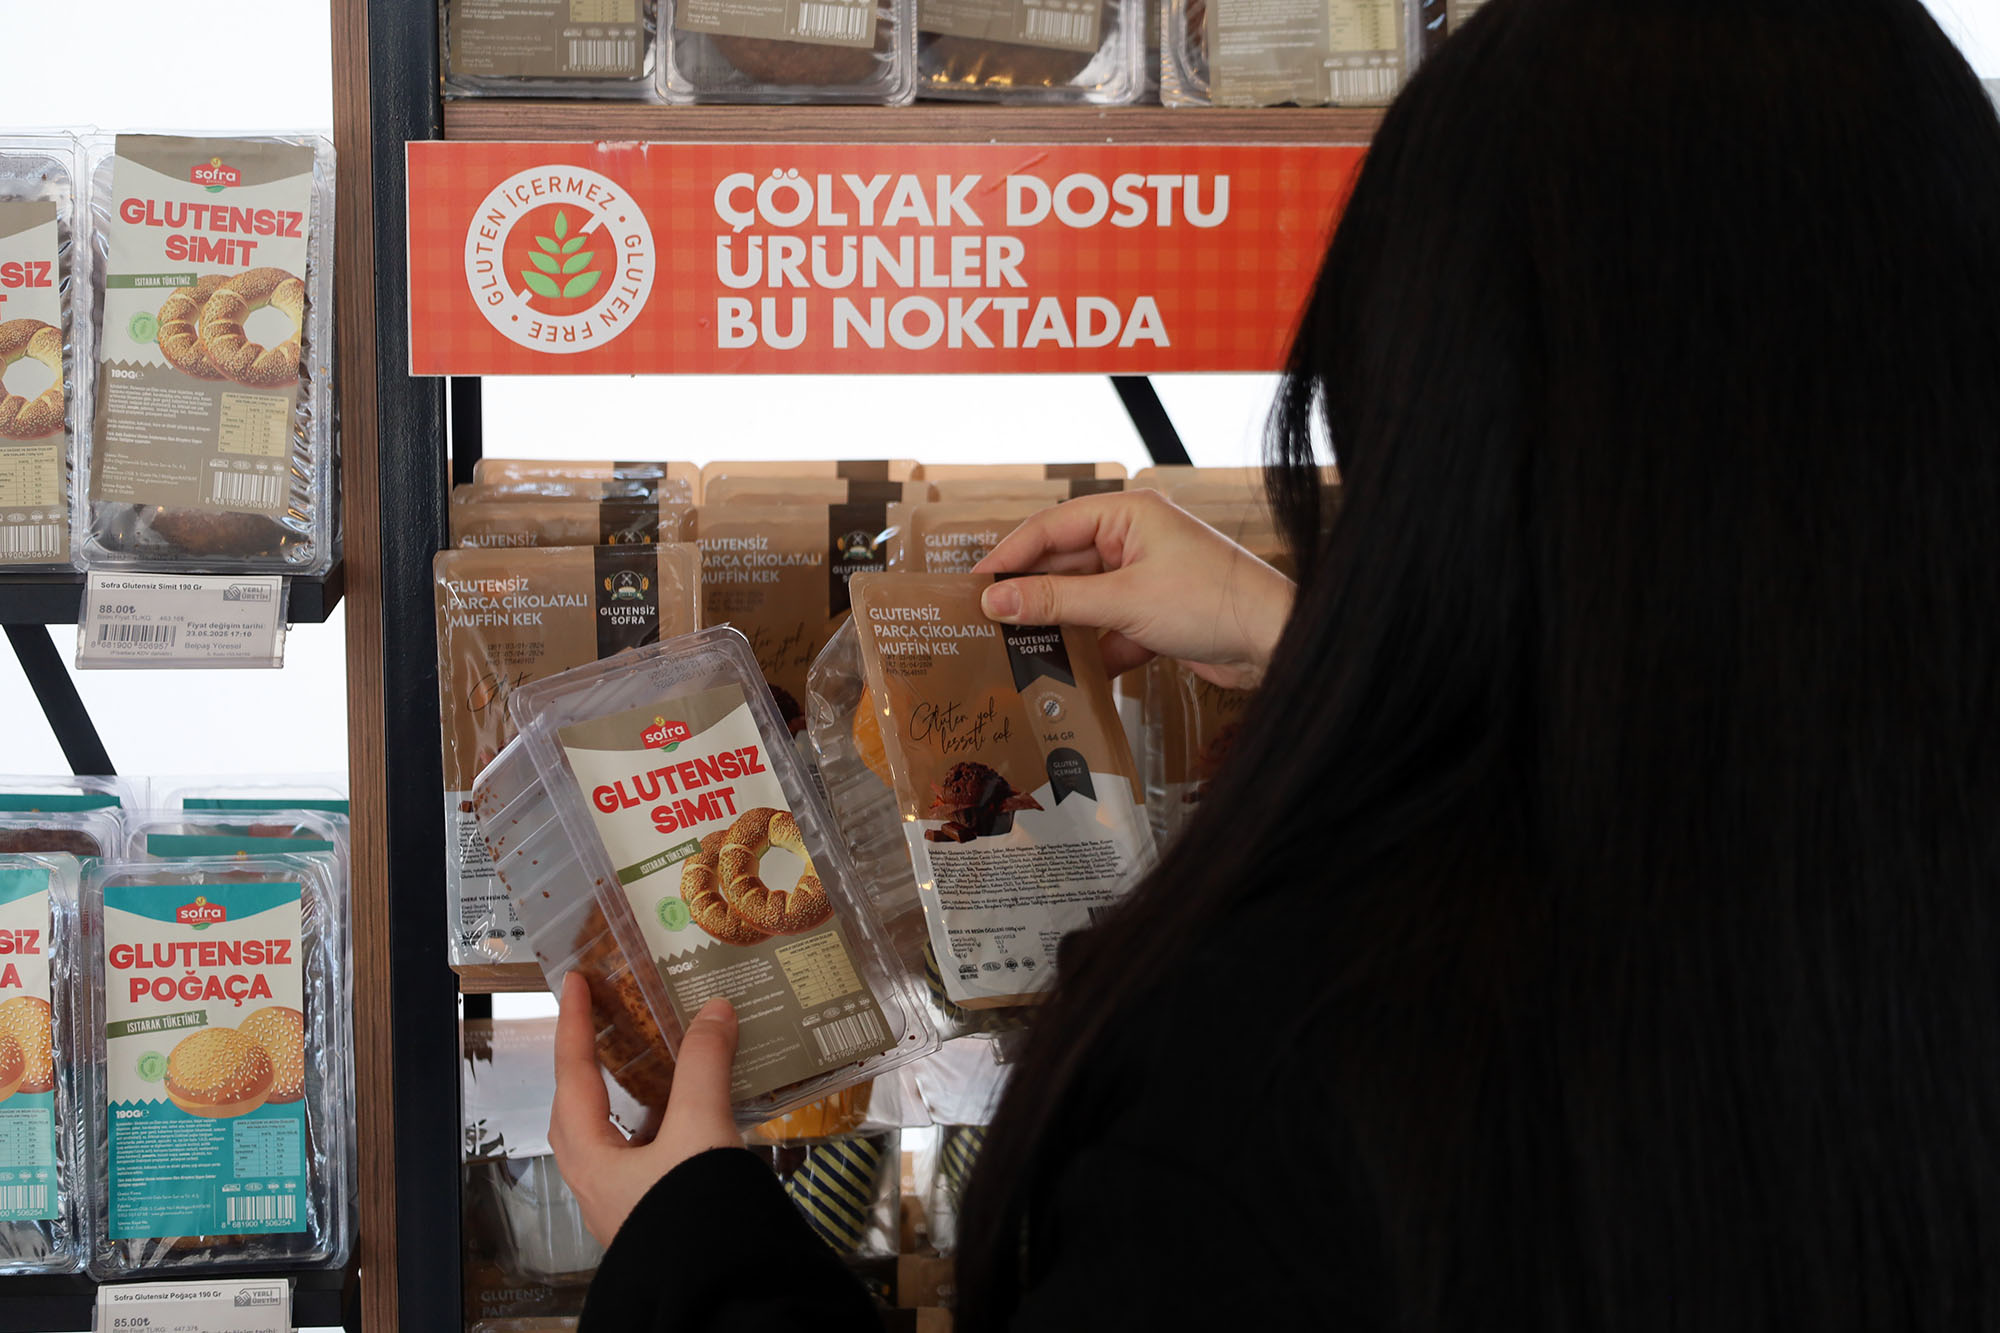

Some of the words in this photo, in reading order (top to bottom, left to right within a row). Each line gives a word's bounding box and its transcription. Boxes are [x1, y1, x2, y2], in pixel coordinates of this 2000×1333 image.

[195, 168, 237, 182] sofra
[714, 167, 983, 238] ÇÖLYAK
[1007, 174, 1230, 229] DOSTU
[476, 208, 506, 306] GLUTEN
[502, 176, 616, 210] İÇERMEZ
[714, 233, 1028, 290] ÜRÜNLER
[599, 234, 644, 328] GLUTEN
[527, 321, 593, 342] FREE
[716, 296, 808, 350] BU
[832, 296, 1171, 349] NOKTADA
[450, 576, 529, 593] GLUTENSİZ
[752, 570, 780, 583] KEK
[101, 581, 121, 589] Sofra
[122, 582, 156, 590] Glutensiz
[449, 596, 500, 612] PARÇA
[502, 593, 588, 611] ÇİKOLATALI
[600, 605, 656, 616] GLUTENSİZ
[451, 611, 509, 628] MUFFİN
[513, 613, 543, 626] KEK
[611, 615, 646, 625] SOFRA
[870, 604, 941, 621] GLUTENSİZ
[874, 624, 919, 641] PARÇA
[920, 622, 996, 641] ÇİKOLATALI
[1007, 634, 1060, 646] GLUTENSİZ
[879, 639, 931, 655] MUFFİN
[932, 642, 960, 655] KEK
[1020, 643, 1053, 655] SOFRA
[645, 727, 686, 744] sofra
[1060, 731, 1074, 740] GR
[1053, 760, 1079, 768] GLUTEN
[180, 906, 221, 920] sofra
[130, 971, 272, 1008] POĞAÇA
[126, 1018, 161, 1033] ISITARAK
[162, 1013, 201, 1030] TÜKETİNİZ
[135, 1293, 168, 1301] Glutensiz
[170, 1292, 197, 1300] Poğaça
